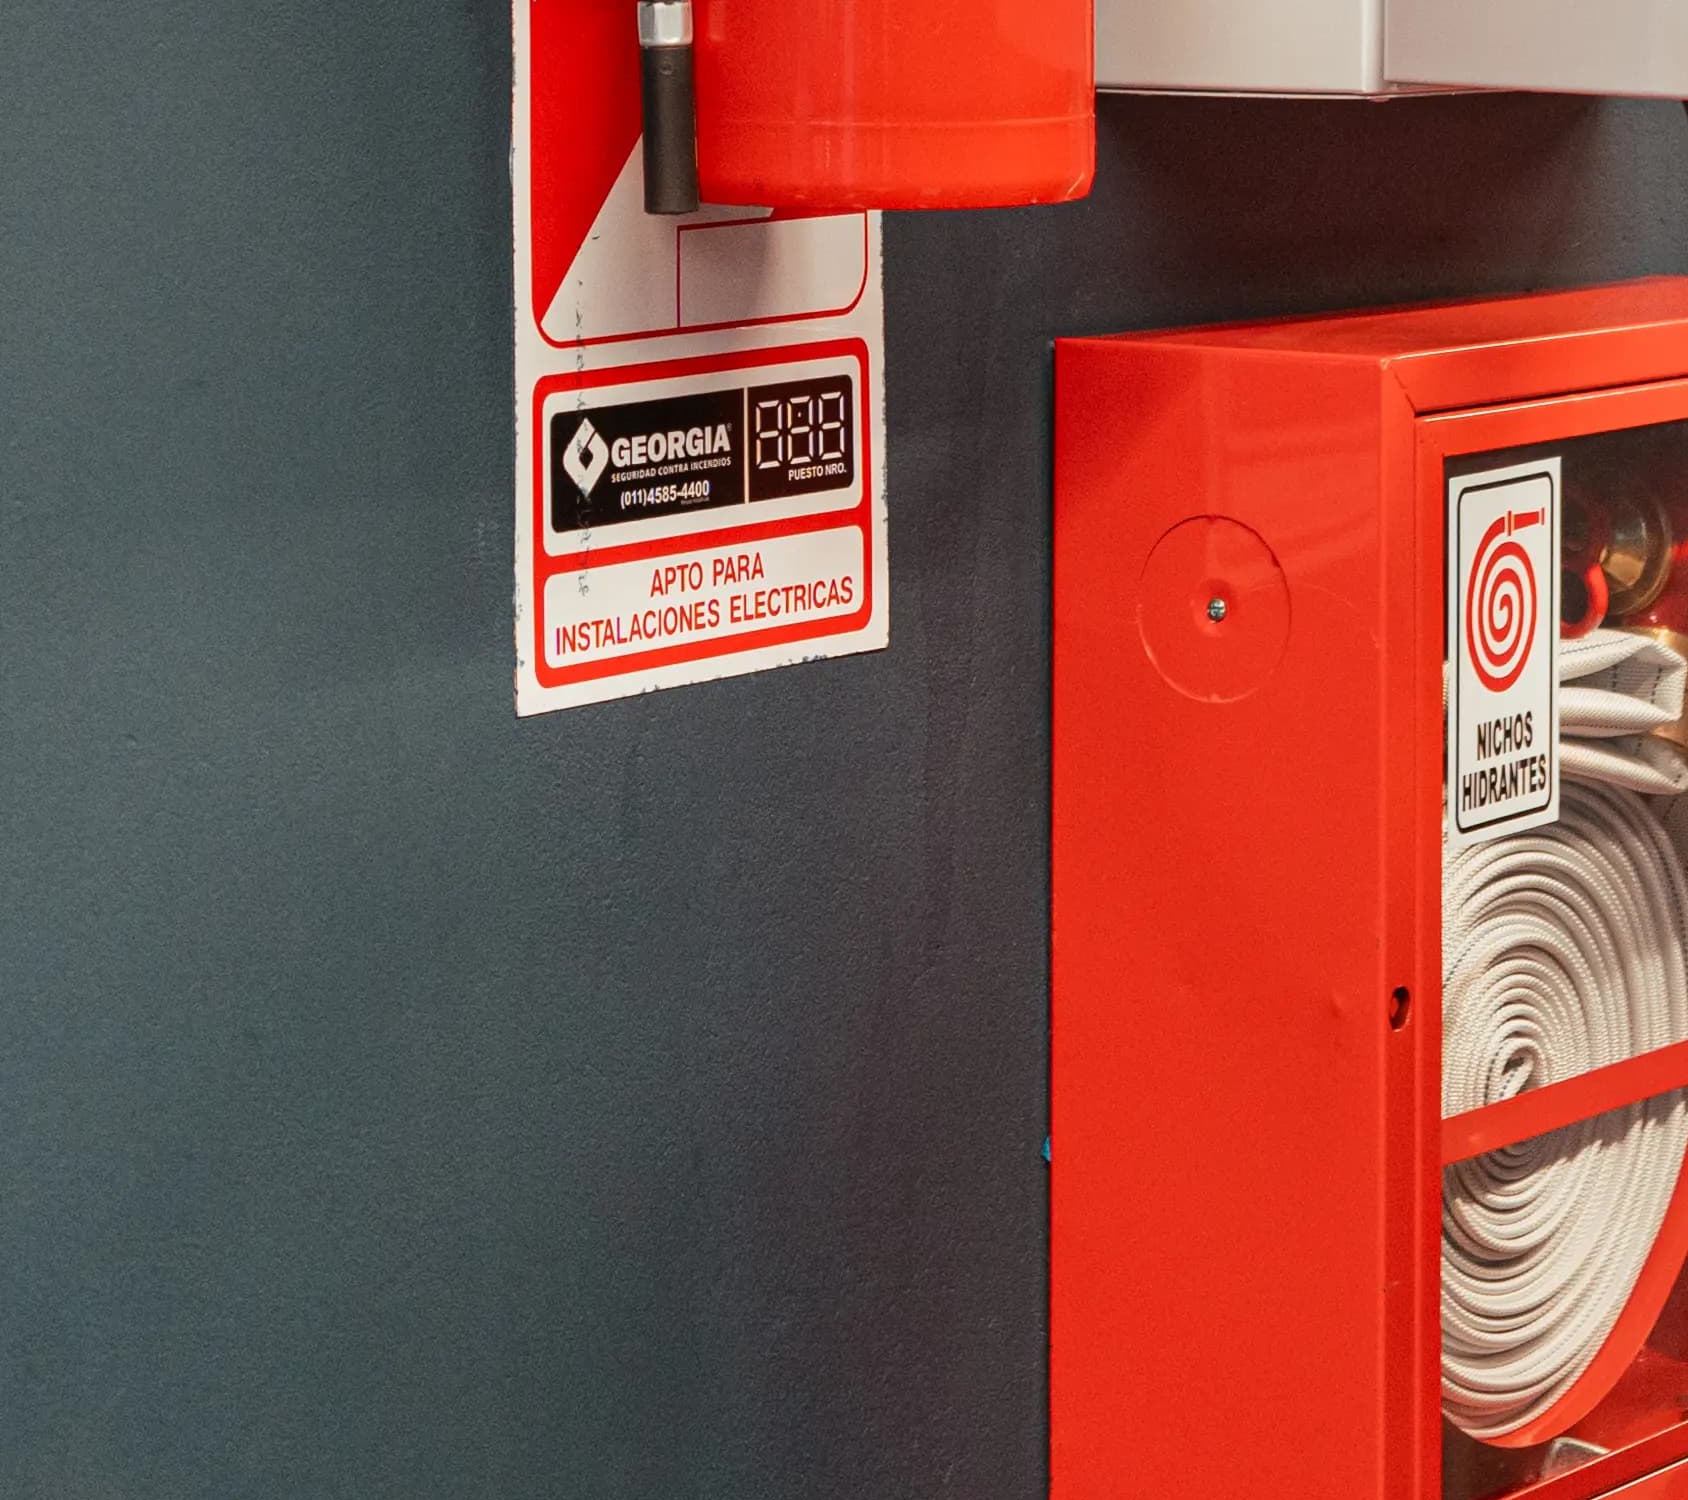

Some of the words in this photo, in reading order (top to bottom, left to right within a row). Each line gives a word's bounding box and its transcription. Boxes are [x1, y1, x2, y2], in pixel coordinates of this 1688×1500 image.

[611, 424, 731, 468] GEORGIA
[611, 469, 656, 484] SEGURIDAD
[658, 463, 689, 477] CONTRA
[690, 457, 732, 471] INCENDIOS
[788, 465, 823, 481] PUESTO
[825, 463, 847, 476] NRO.
[620, 480, 710, 510] (011)4585-4400
[650, 562, 702, 598] APTO
[713, 552, 764, 587] PARA
[556, 600, 720, 656] INSTALACIONES
[730, 576, 853, 624] ELECTRICAS
[1477, 711, 1532, 761] NICHOS
[1462, 755, 1546, 812] HIDRANTES
